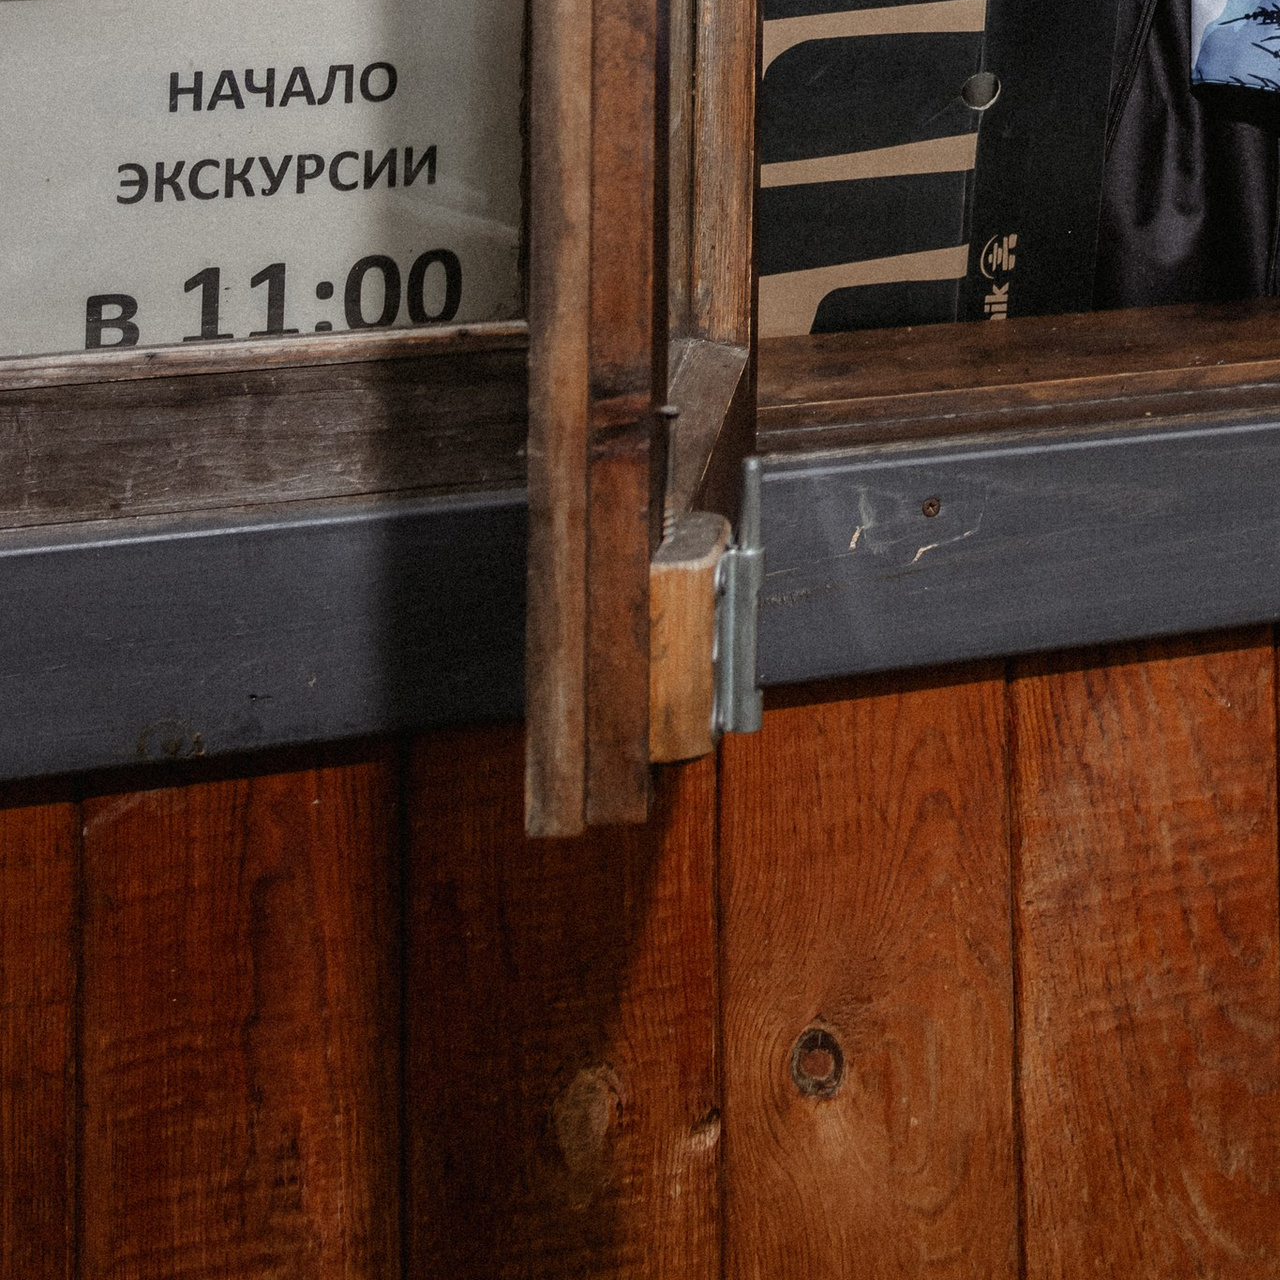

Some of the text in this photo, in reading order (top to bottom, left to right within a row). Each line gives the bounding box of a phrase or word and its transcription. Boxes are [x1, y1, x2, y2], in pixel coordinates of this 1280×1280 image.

[168, 61, 398, 113] НАЧАЛО
[116, 144, 438, 204] ЭКСКУРСИИ
[182, 248, 462, 342] 11:00
